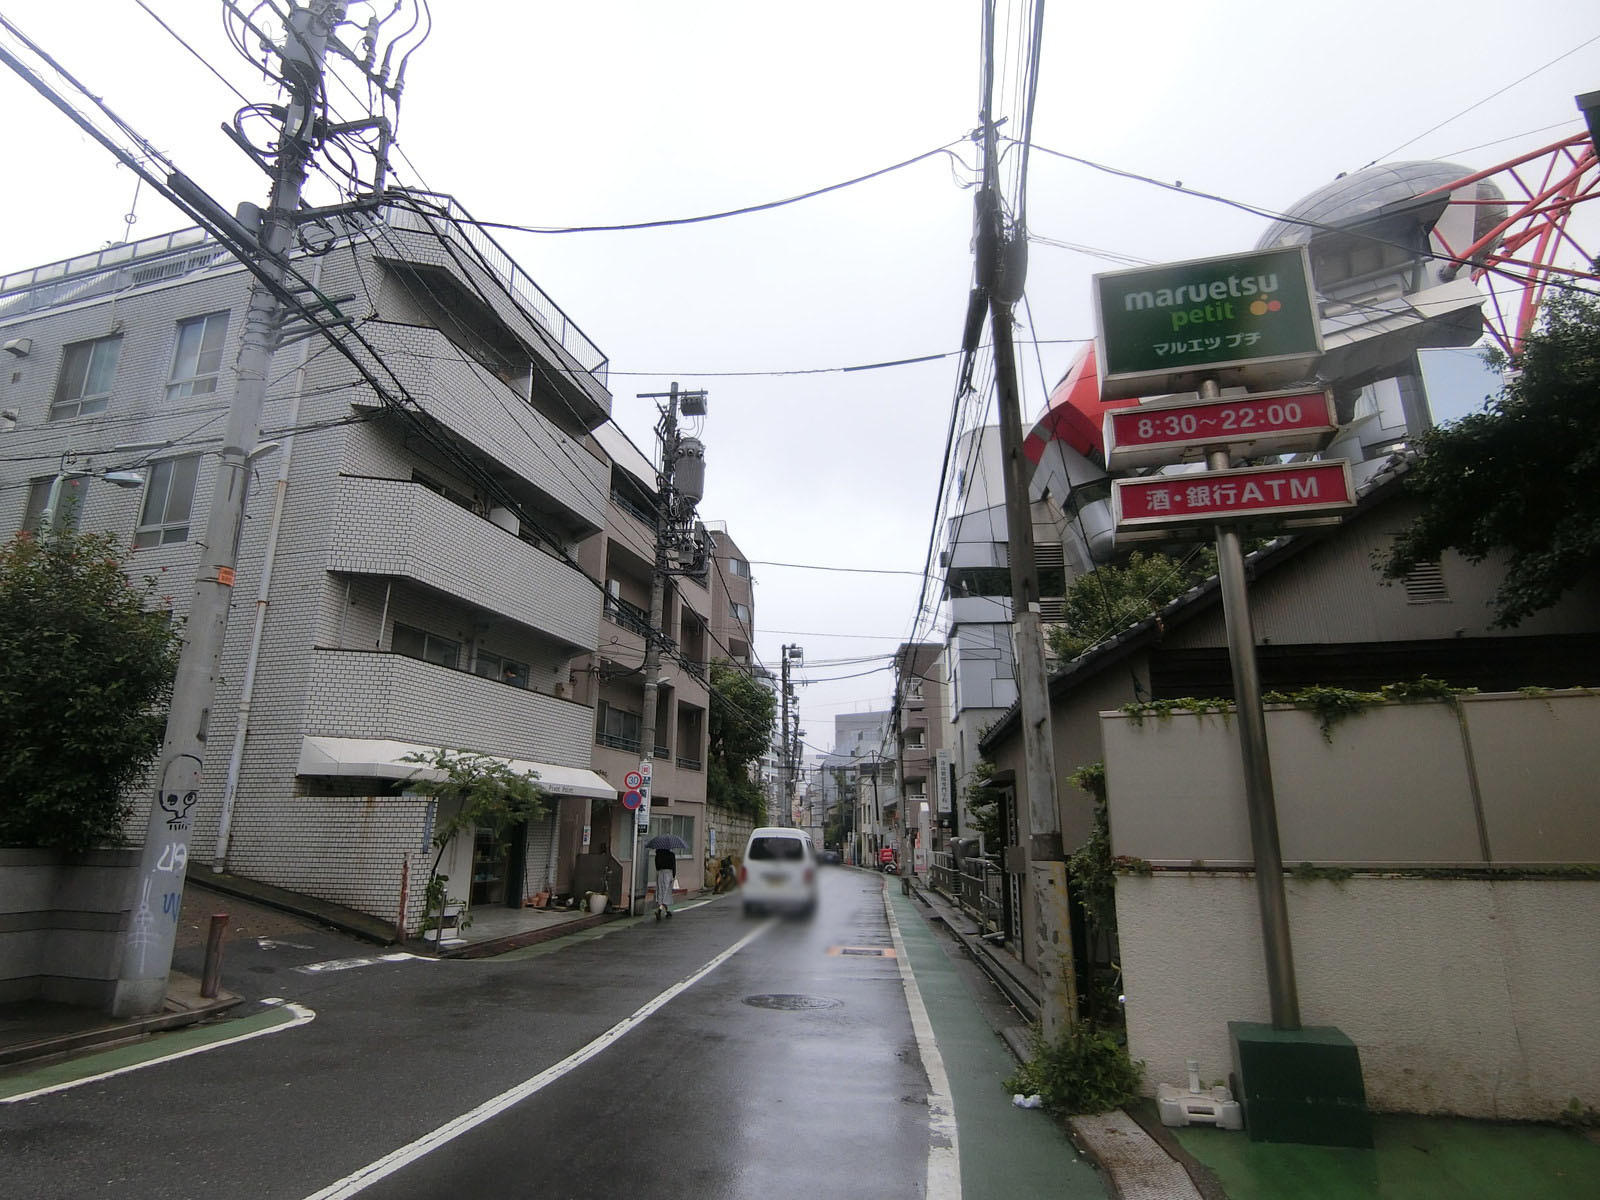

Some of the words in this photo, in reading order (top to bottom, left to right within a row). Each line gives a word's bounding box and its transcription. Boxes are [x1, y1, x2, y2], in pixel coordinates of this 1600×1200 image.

[1124, 272, 1279, 312] maruetsu
[1171, 301, 1236, 332] petit
[1153, 336, 1222, 357] マルエツ
[1226, 331, 1262, 348] プチ
[1146, 476, 1319, 511] 酒・銀行ATM
[628, 776, 639, 785] 30
